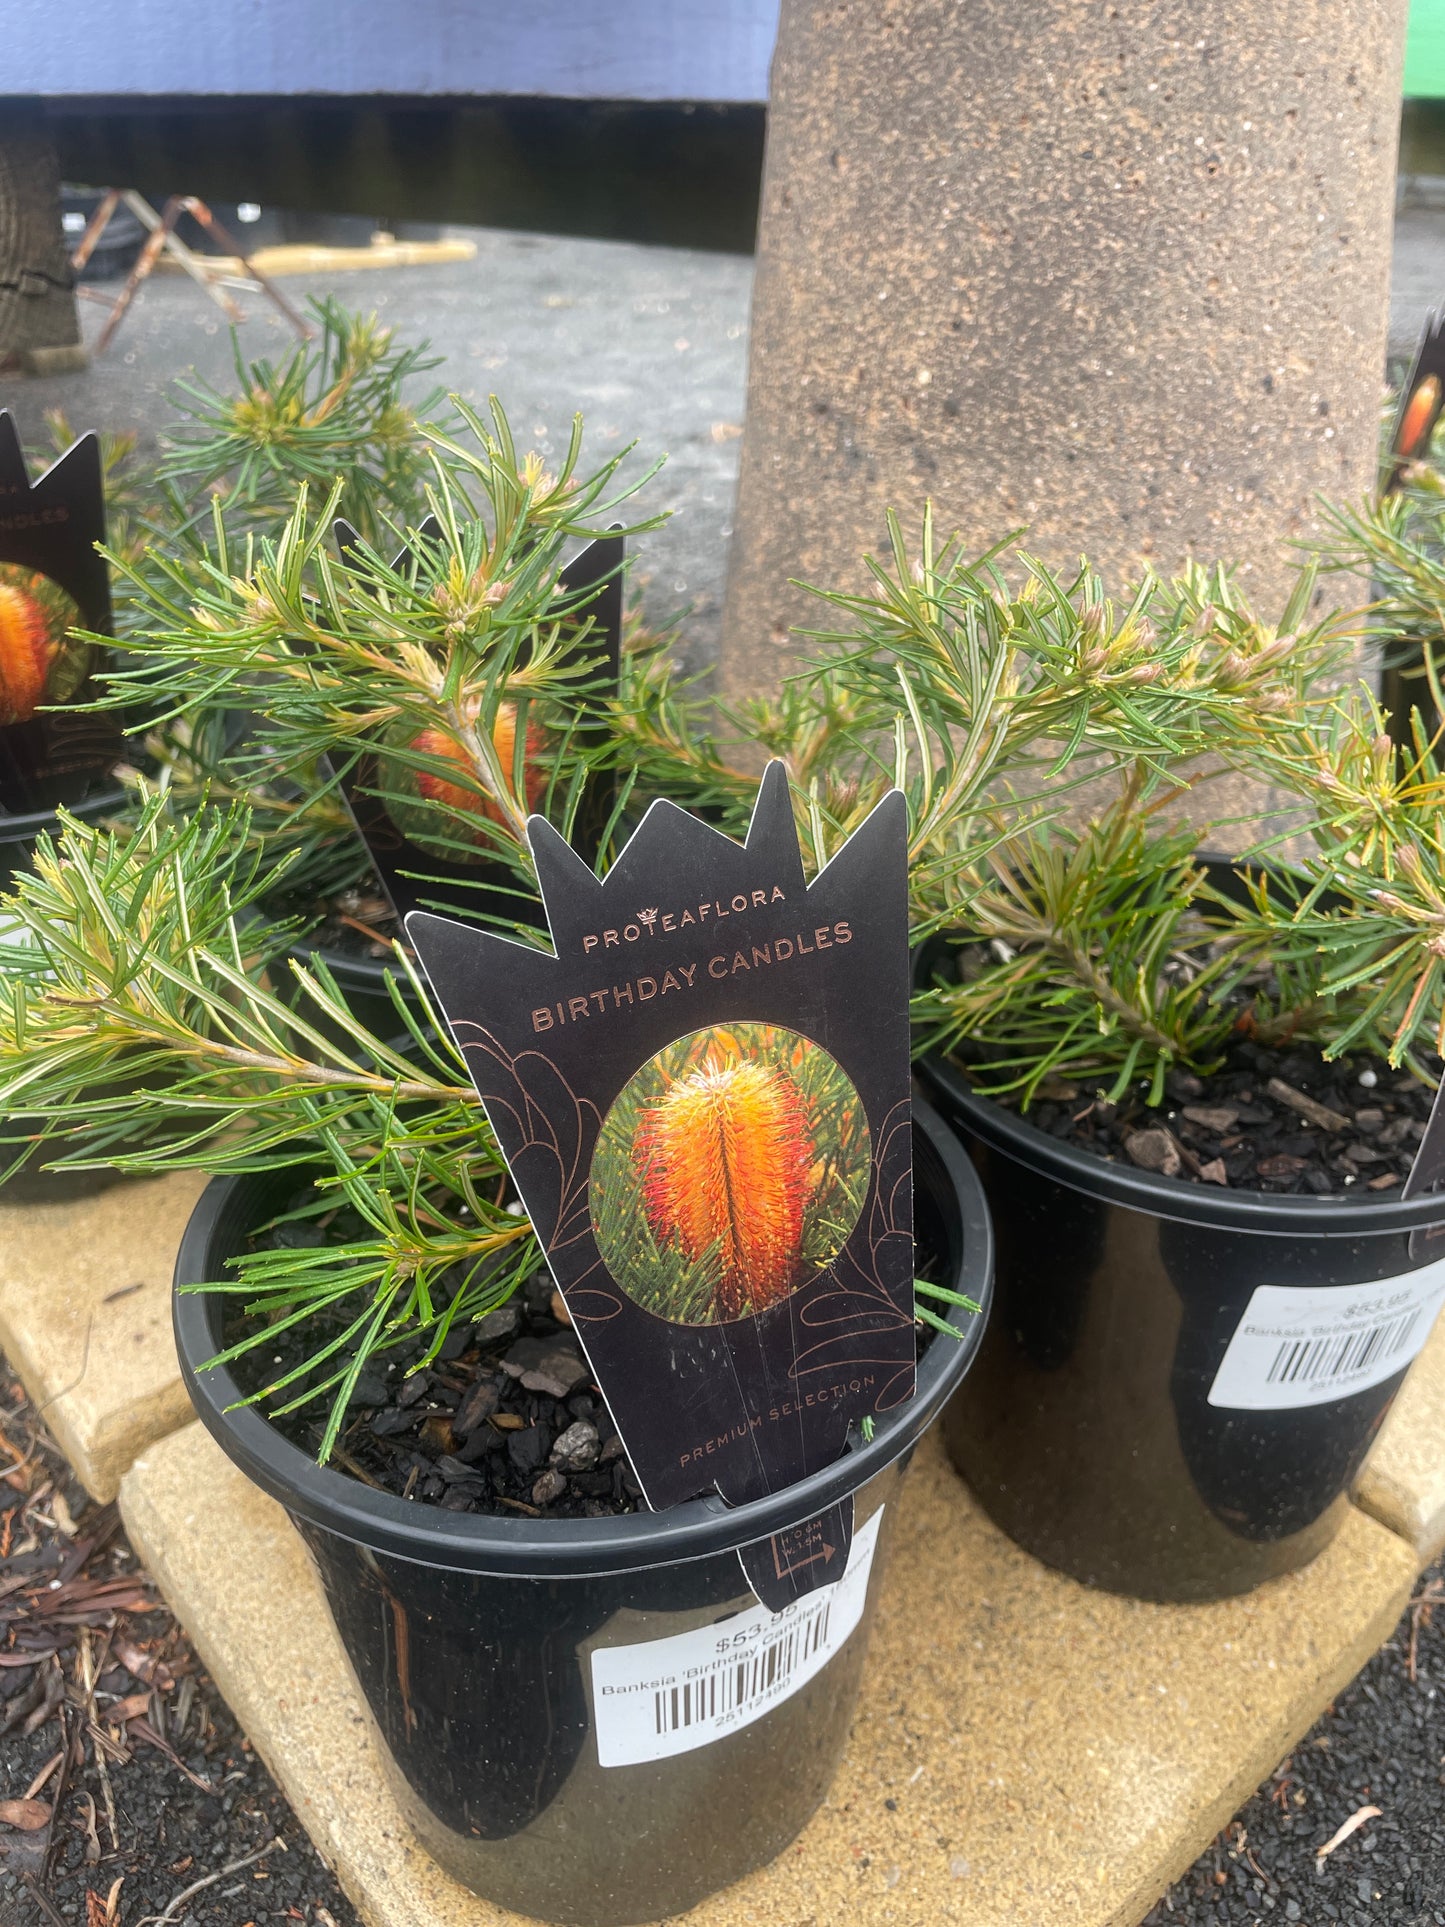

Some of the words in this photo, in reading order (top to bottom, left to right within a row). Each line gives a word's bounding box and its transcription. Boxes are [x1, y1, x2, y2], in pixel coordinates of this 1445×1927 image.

[582, 886, 786, 954] PROTEAFLORA
[531, 962, 698, 1033] BIRTHDAY
[707, 921, 854, 979] CANDLES
[680, 1415, 763, 1468] PREMIUM
[768, 1375, 876, 1421] SELECTION
[715, 1603, 799, 1654] $53.95
[602, 1676, 676, 1696] Banksia
